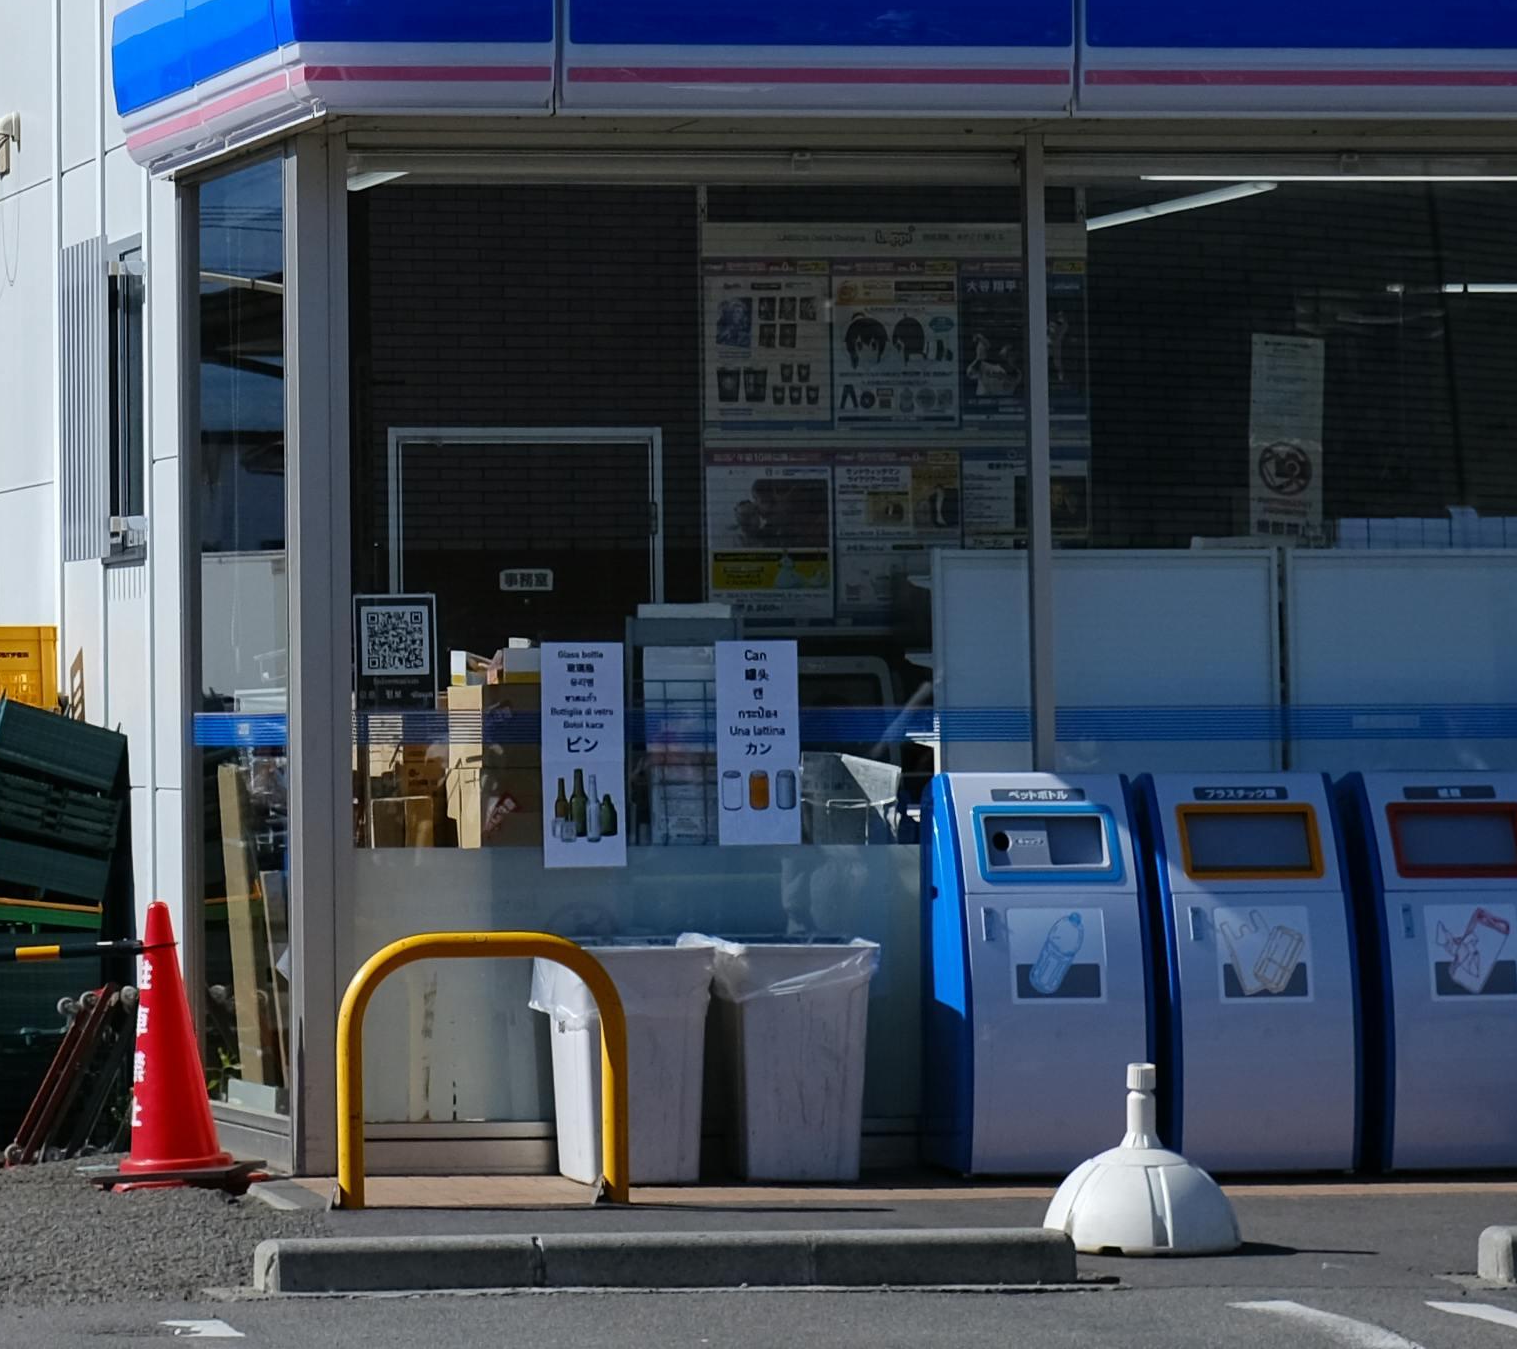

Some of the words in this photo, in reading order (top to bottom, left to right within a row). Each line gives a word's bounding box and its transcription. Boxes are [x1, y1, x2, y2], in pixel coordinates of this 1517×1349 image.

[744, 649, 767, 661] Can
[729, 725, 751, 736] Una
[753, 725, 786, 736] lattina
[745, 742, 773, 755] カン
[1008, 789, 1069, 800] ペットボトル
